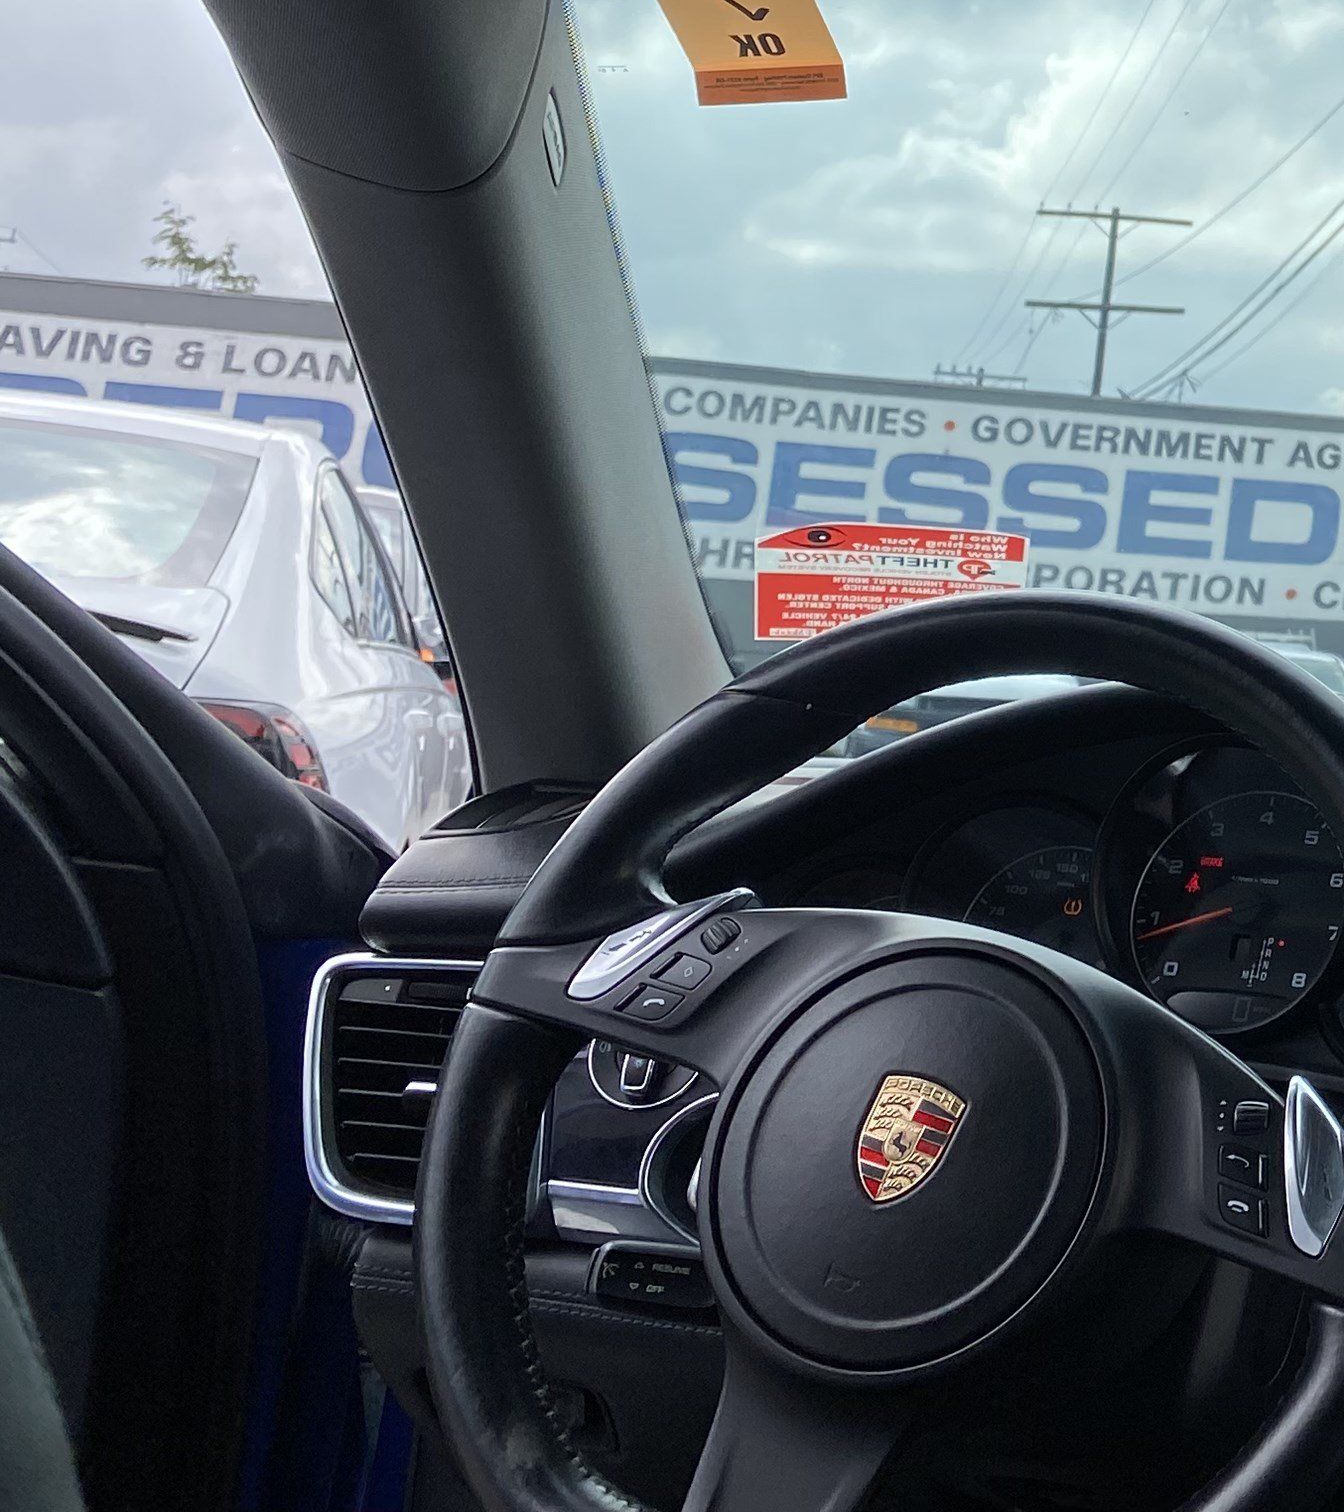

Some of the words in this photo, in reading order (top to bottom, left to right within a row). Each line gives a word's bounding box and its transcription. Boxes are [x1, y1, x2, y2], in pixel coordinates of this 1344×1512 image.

[175, 341, 204, 371] &
[222, 345, 357, 383] LOAN
[664, 387, 926, 437] COMPANIES
[971, 415, 1274, 466] GOVERNMENT
[1259, 811, 1275, 826] 4
[1210, 822, 1225, 837] 3
[1304, 831, 1320, 845] 5
[1169, 860, 1184, 874] 2
[1330, 874, 1344, 888] 6
[1150, 911, 1161, 925] 1
[1328, 926, 1339, 940] 7
[1163, 961, 1178, 976] 0
[1292, 973, 1307, 988] 8
[884, 1078, 964, 1118] PORSCHE
